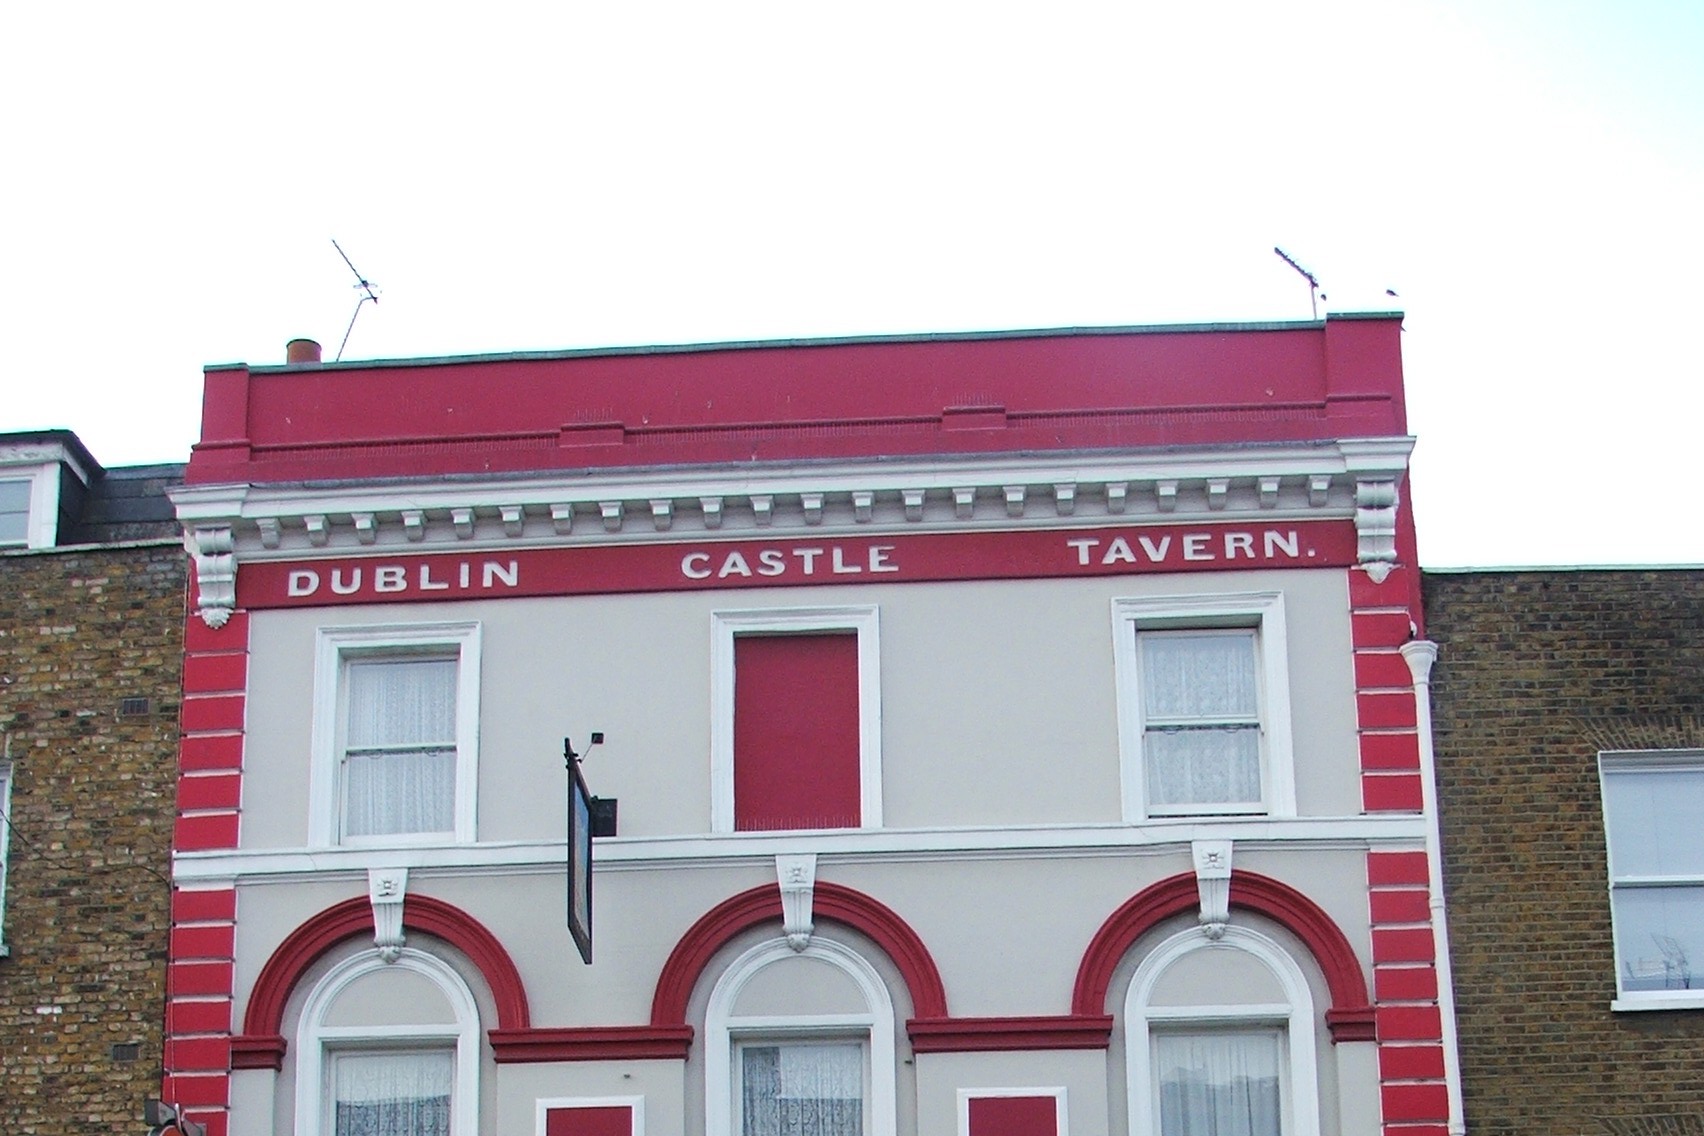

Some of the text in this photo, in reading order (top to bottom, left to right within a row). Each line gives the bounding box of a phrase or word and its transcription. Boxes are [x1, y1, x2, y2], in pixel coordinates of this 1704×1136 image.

[287, 530, 1316, 597] DUBLIN CASTLE TAVERN.
